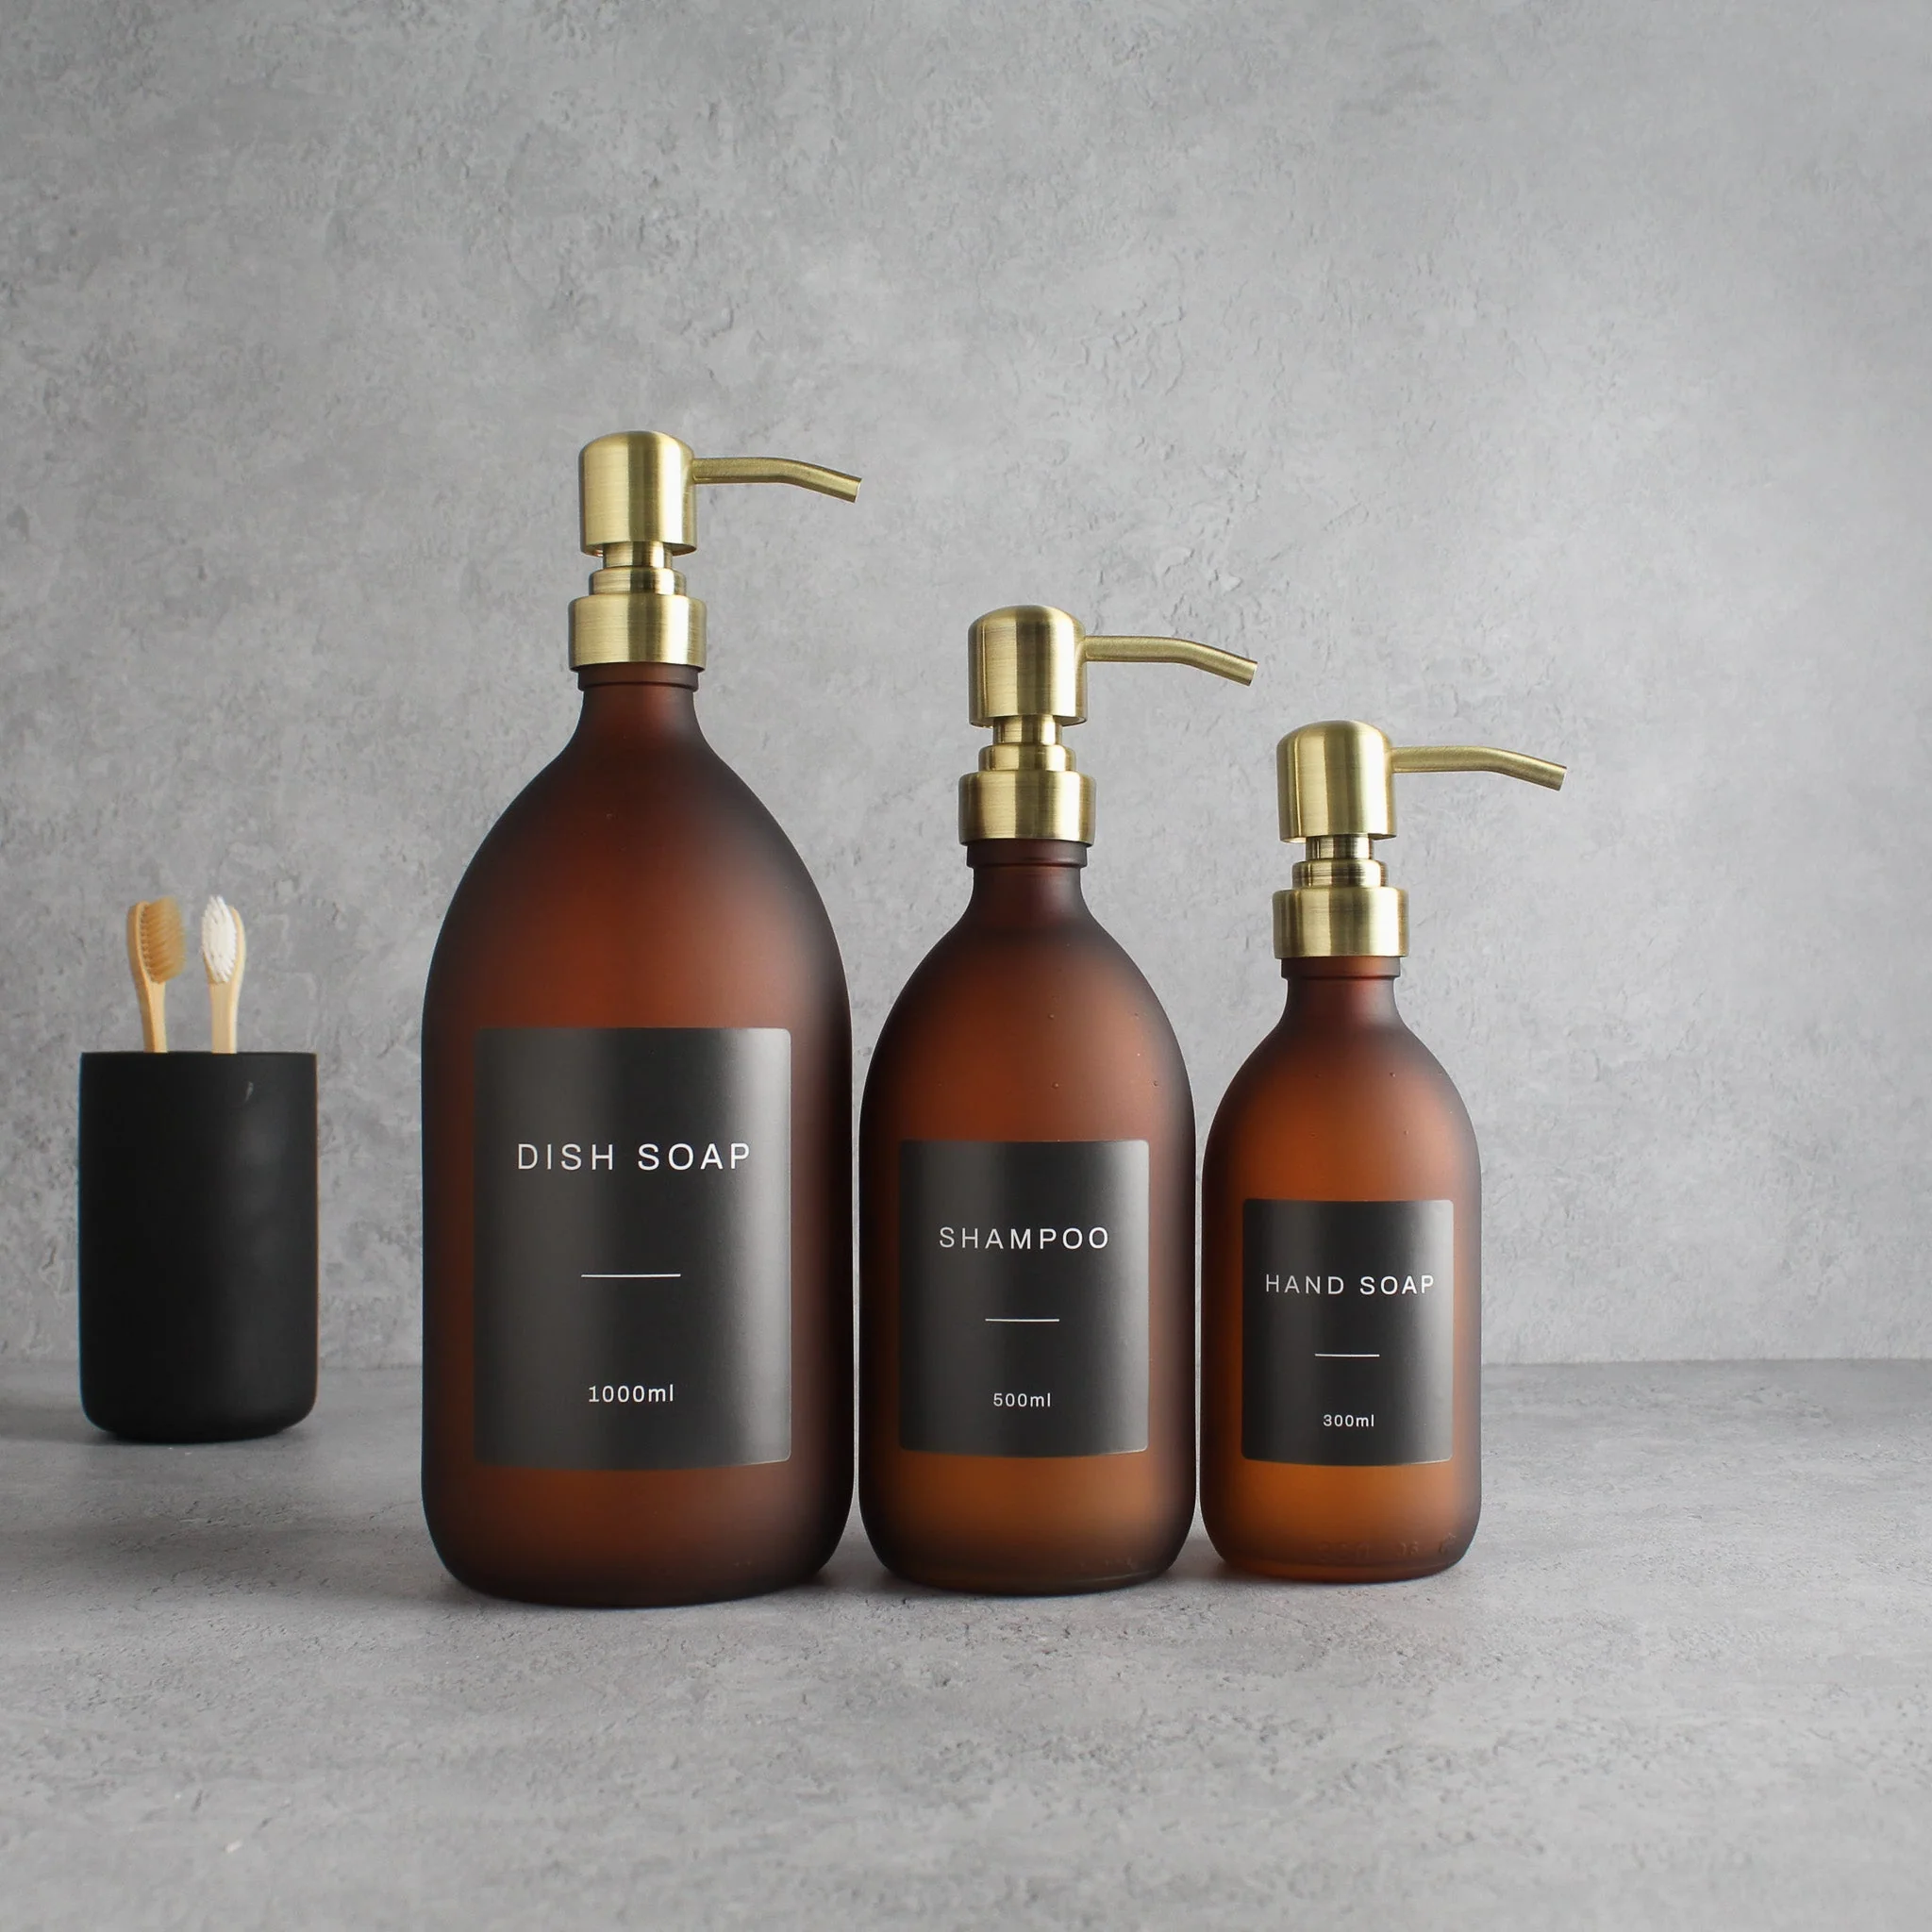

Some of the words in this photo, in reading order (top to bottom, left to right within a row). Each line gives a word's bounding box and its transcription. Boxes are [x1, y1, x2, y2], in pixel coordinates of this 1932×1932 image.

[517, 1142, 613, 1171] DISH
[637, 1142, 750, 1171] SOAP
[939, 1225, 1108, 1250] SHAMPOO
[1265, 1274, 1344, 1295] HAND
[1359, 1274, 1434, 1295] SOAP
[588, 1384, 674, 1403] 1000ml
[992, 1391, 1051, 1407] 500ml
[1323, 1414, 1374, 1427] 300ml
